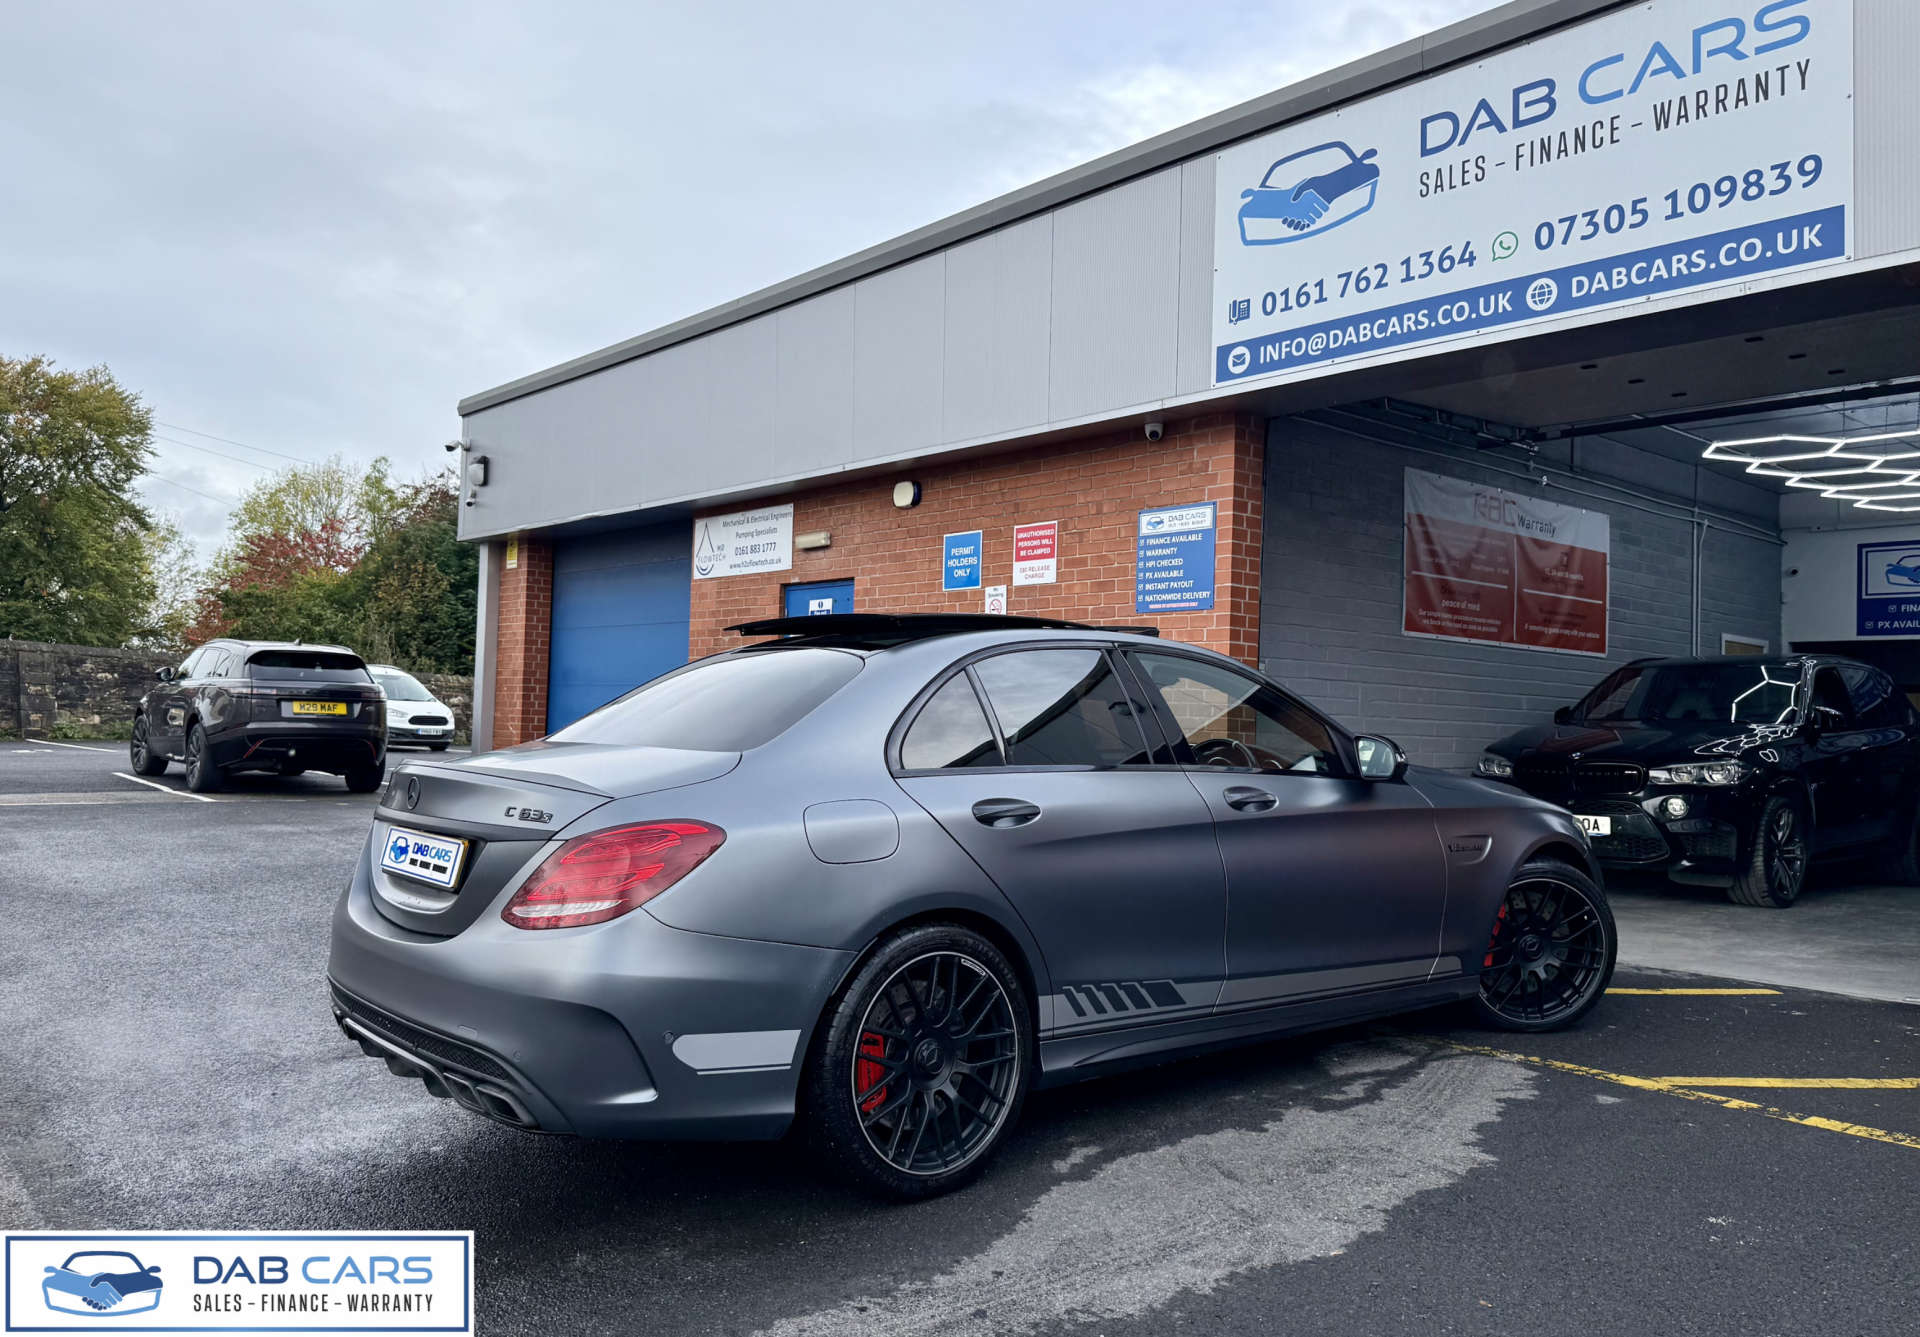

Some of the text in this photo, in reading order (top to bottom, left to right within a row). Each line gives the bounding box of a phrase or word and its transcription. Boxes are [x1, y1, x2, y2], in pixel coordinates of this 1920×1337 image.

[1420, 0, 1811, 158] DAB CARS
[1420, 155, 1486, 198] SALES
[1515, 115, 1620, 172] FINANCE
[1653, 59, 1811, 132] WARRANTY
[1534, 154, 1823, 250] 07305 109839
[1571, 224, 1823, 297] DABCARS.CO.UK
[1262, 241, 1477, 316] 0161 762 1364
[1259, 291, 1513, 364] INFO@DABCARS.CO.UK
[722, 517, 745, 527] Mechanical
[751, 513, 770, 524] Electrical
[1185, 512, 1206, 520] CARS
[1517, 513, 1556, 537] Warranty
[1018, 539, 1040, 548] PERSONS
[1146, 533, 1203, 546] FINANCE AVAILABLE
[735, 546, 748, 556] 0161
[762, 542, 776, 552] 1777
[951, 546, 974, 556] PERMIT
[1028, 548, 1051, 556] CLAMPED
[1146, 547, 1178, 557] WARRANTY
[947, 557, 977, 568] HOLDERS
[1146, 558, 1184, 568] HPI CHECKED
[954, 568, 970, 577] ONLY
[1028, 565, 1051, 573] RELEASE
[1154, 570, 1184, 578] AVAILABLE
[1024, 572, 1045, 580] CHARGE
[1145, 580, 1193, 591] INSTANT PAYOUT
[1145, 591, 1211, 602] NATIONWIDE DELIVERY
[1878, 621, 1890, 629] PX
[504, 806, 517, 817] C
[412, 842, 452, 862] DAB CARS
